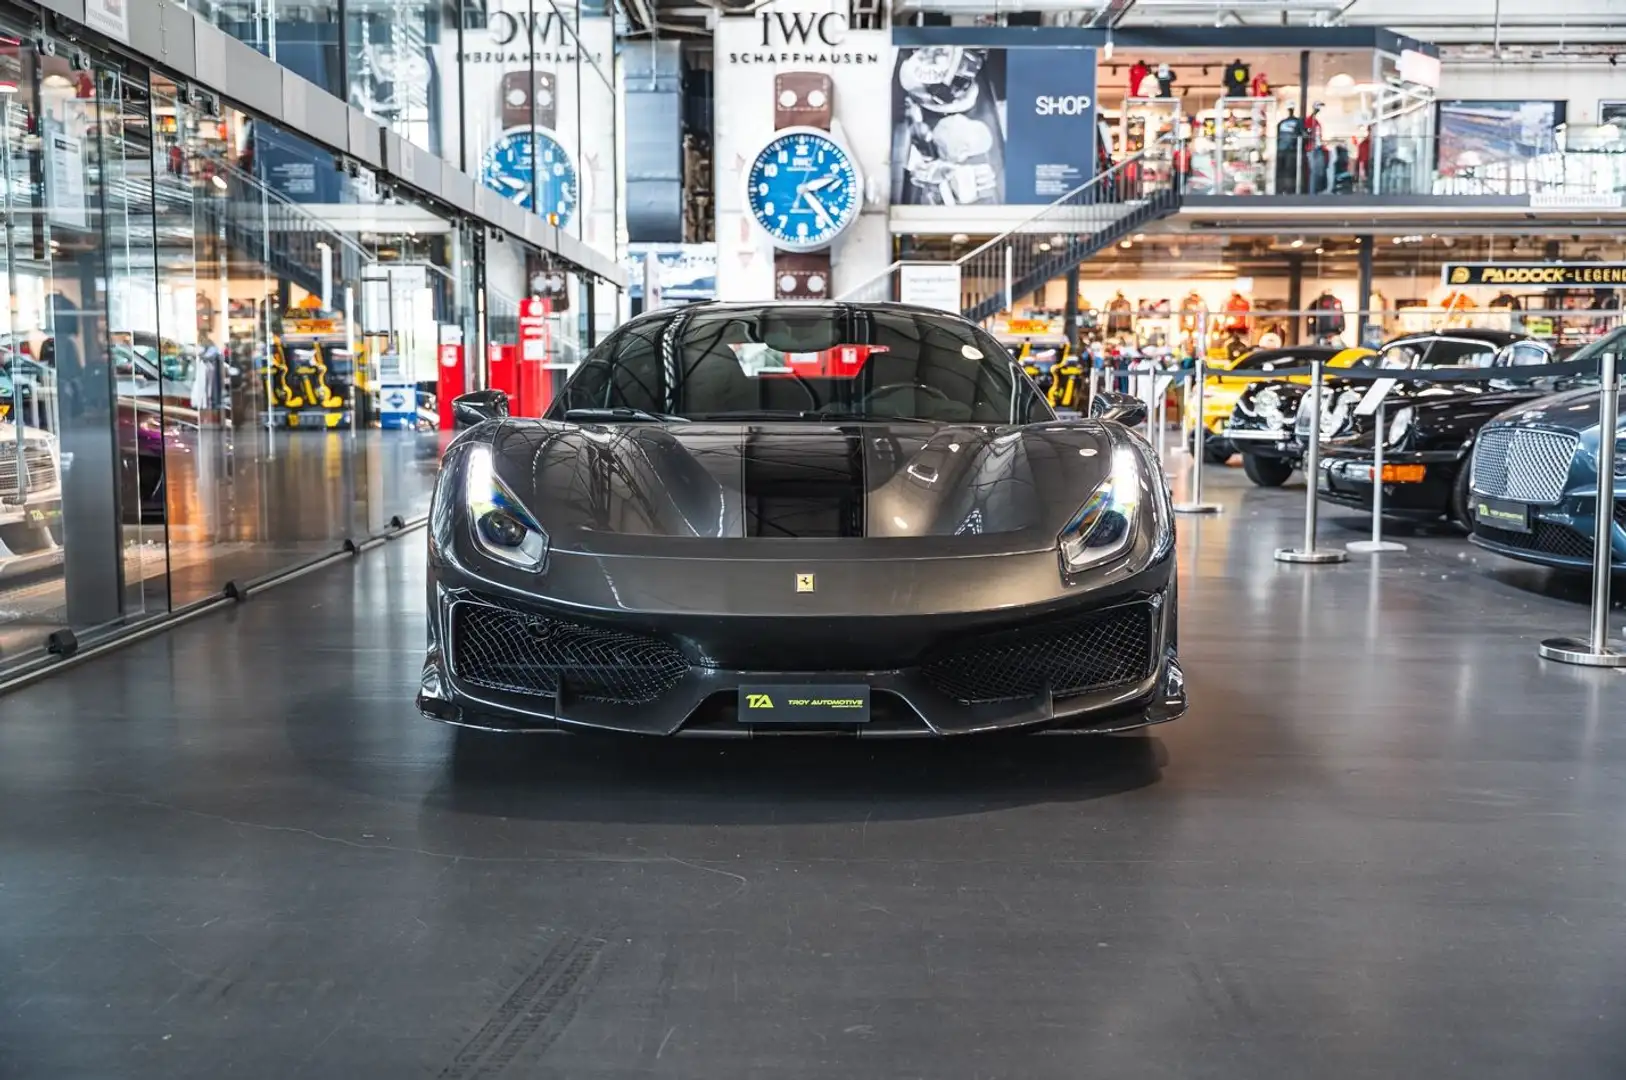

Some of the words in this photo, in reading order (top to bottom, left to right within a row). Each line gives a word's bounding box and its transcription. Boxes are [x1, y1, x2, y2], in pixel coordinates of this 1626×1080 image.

[760, 11, 846, 46] IWC
[730, 52, 878, 64] SCHAFFHAUSEN
[1035, 95, 1091, 115] SHOP
[745, 694, 774, 708] TA
